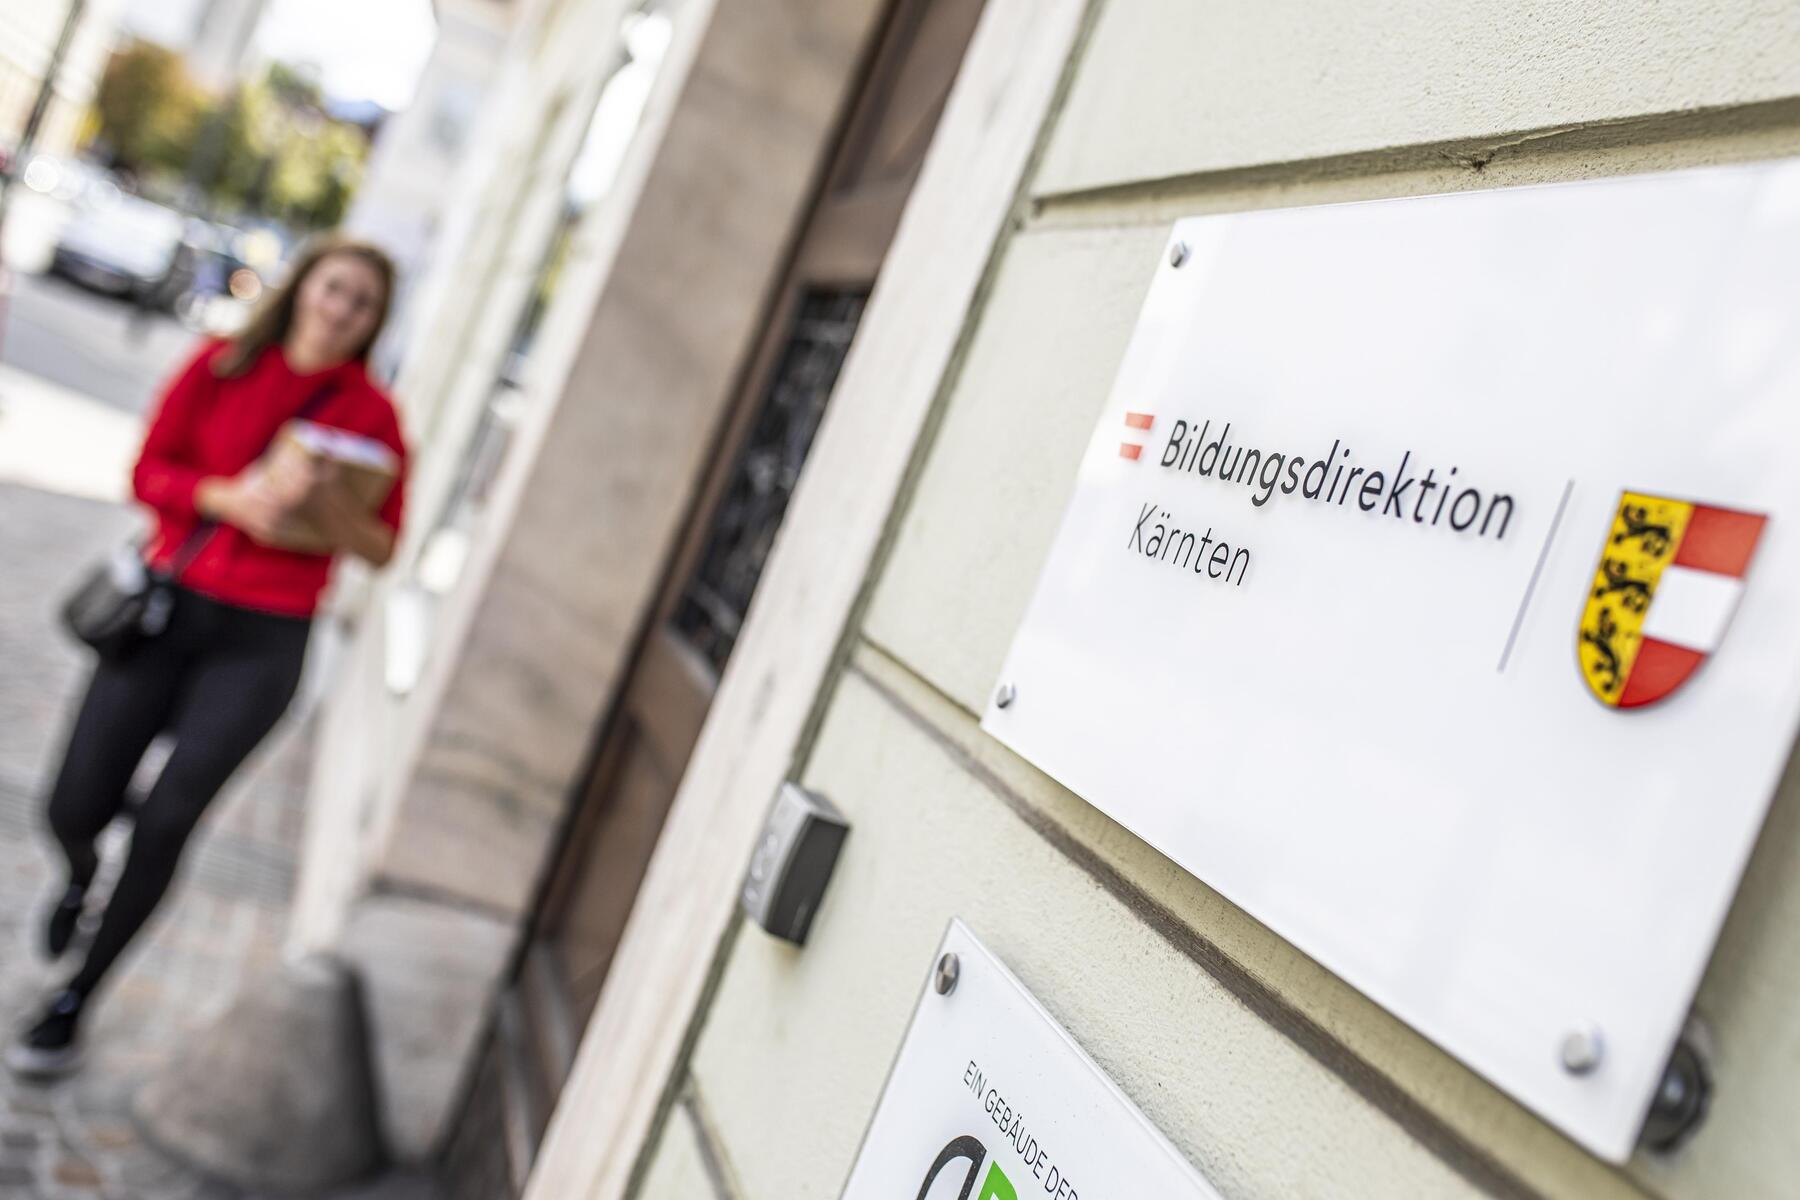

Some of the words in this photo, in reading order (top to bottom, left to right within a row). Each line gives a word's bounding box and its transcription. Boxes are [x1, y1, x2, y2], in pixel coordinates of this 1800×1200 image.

[1161, 419, 1515, 540] Bildungsdirektion
[1128, 502, 1251, 586] Kärnten
[963, 1060, 988, 1100] EIN
[984, 1089, 1048, 1180] GEBÄUDE
